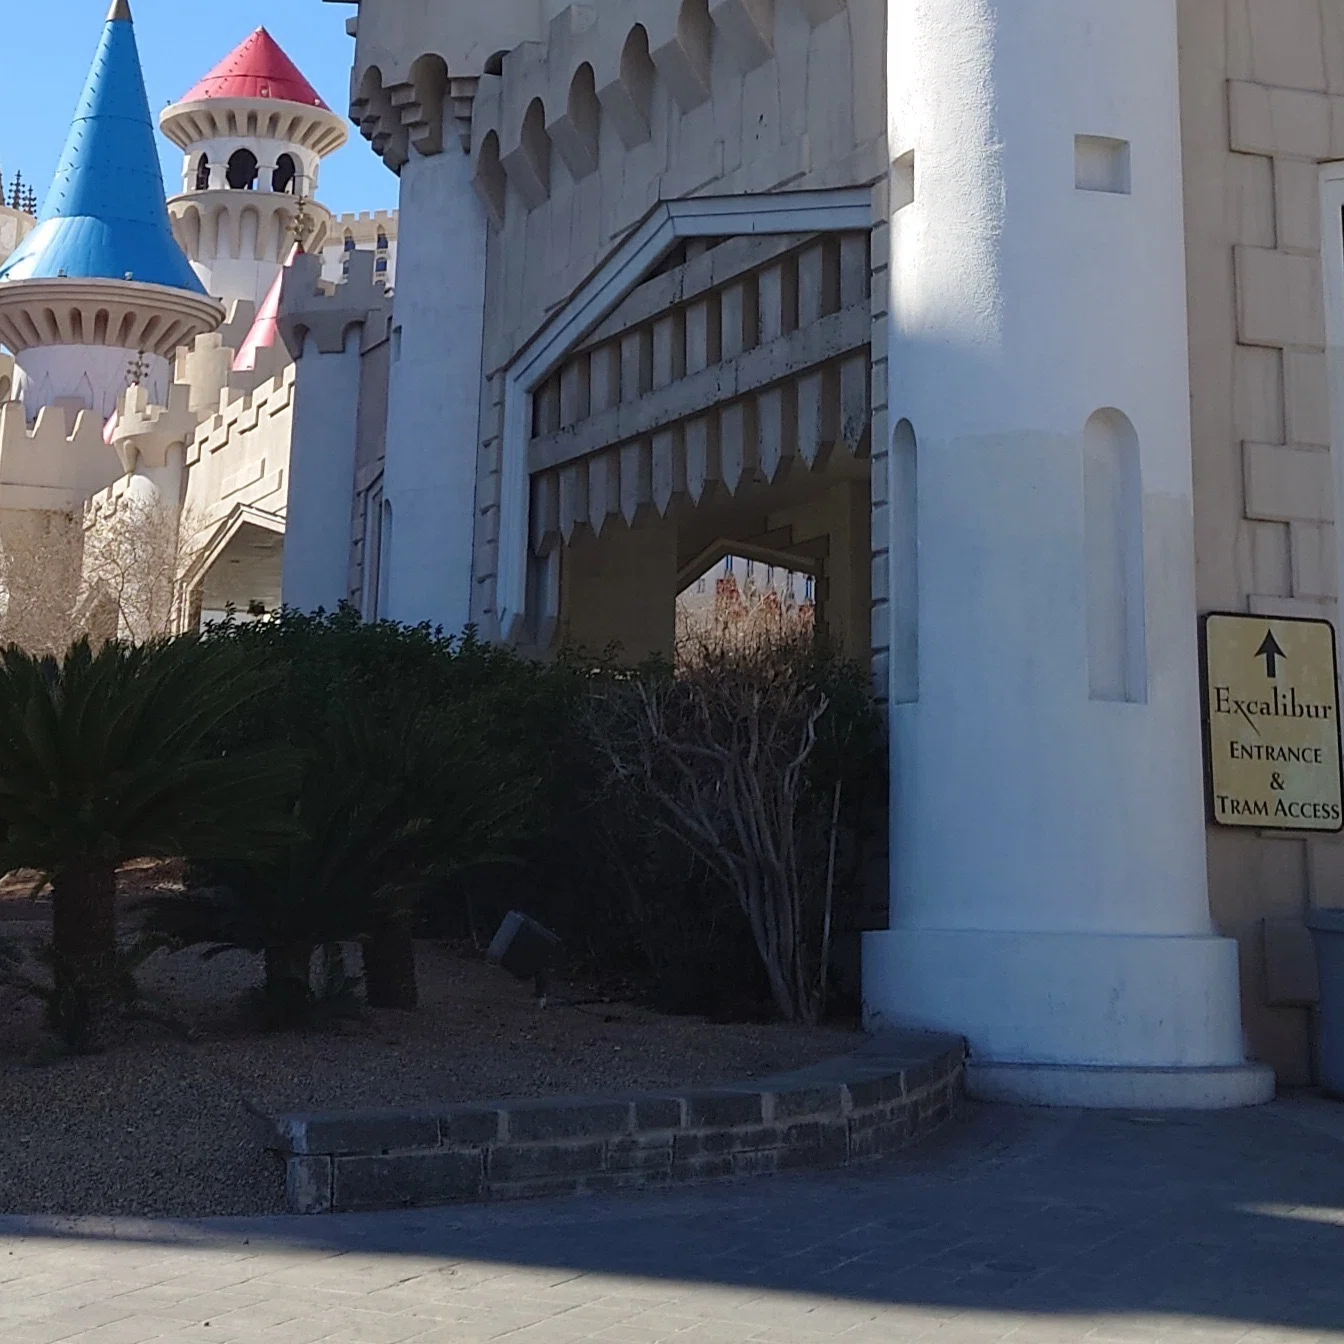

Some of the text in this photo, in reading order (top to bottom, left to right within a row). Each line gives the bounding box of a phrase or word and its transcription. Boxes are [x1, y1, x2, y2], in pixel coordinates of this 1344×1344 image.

[1214, 686, 1332, 736] Excalibur
[1229, 740, 1322, 763] ENTRANCE
[1270, 772, 1285, 790] &
[1216, 795, 1340, 820] TRAM ACCESS
